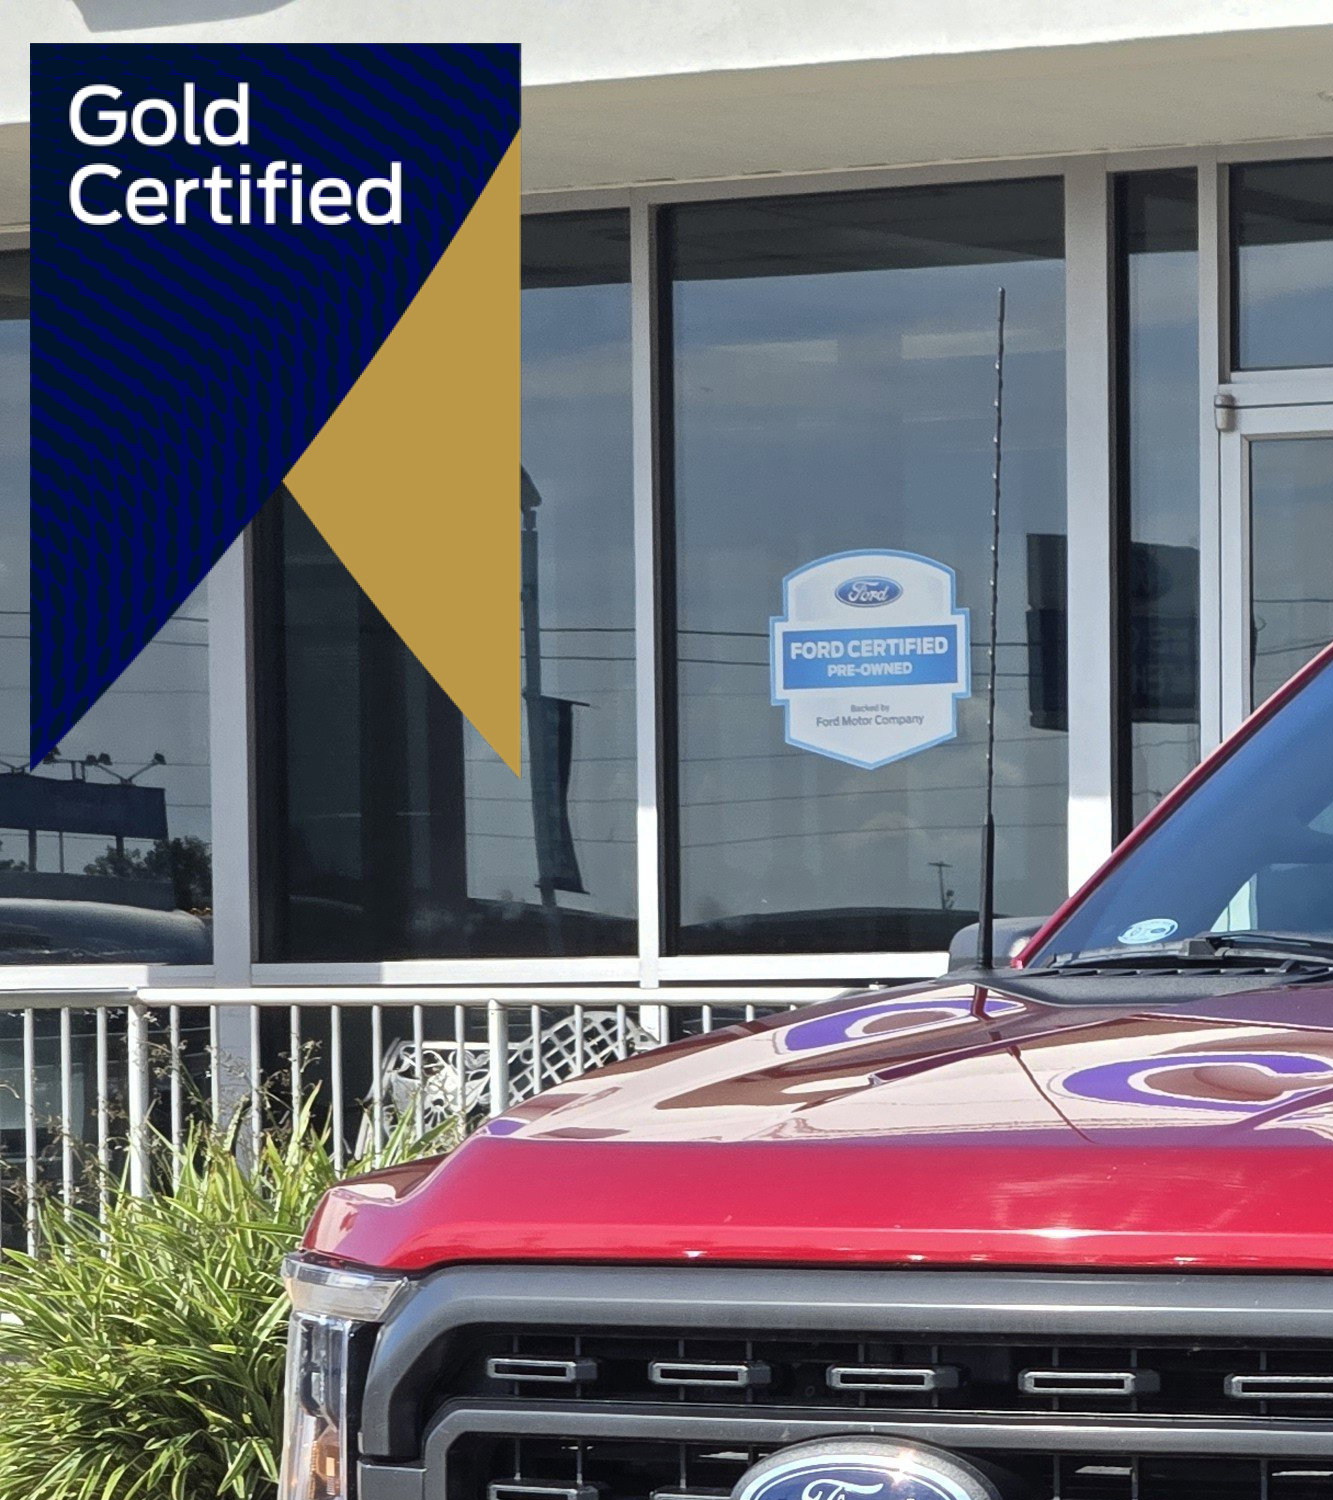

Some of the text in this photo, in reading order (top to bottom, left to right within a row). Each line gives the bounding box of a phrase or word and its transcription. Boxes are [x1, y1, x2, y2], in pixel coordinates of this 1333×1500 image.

[847, 581, 890, 603] Ford
[790, 637, 949, 660] FORD CERTIFIED
[827, 662, 913, 677] PRE-OWNED
[850, 704, 890, 713] Backed by
[816, 713, 925, 727] Ford Motor Company
